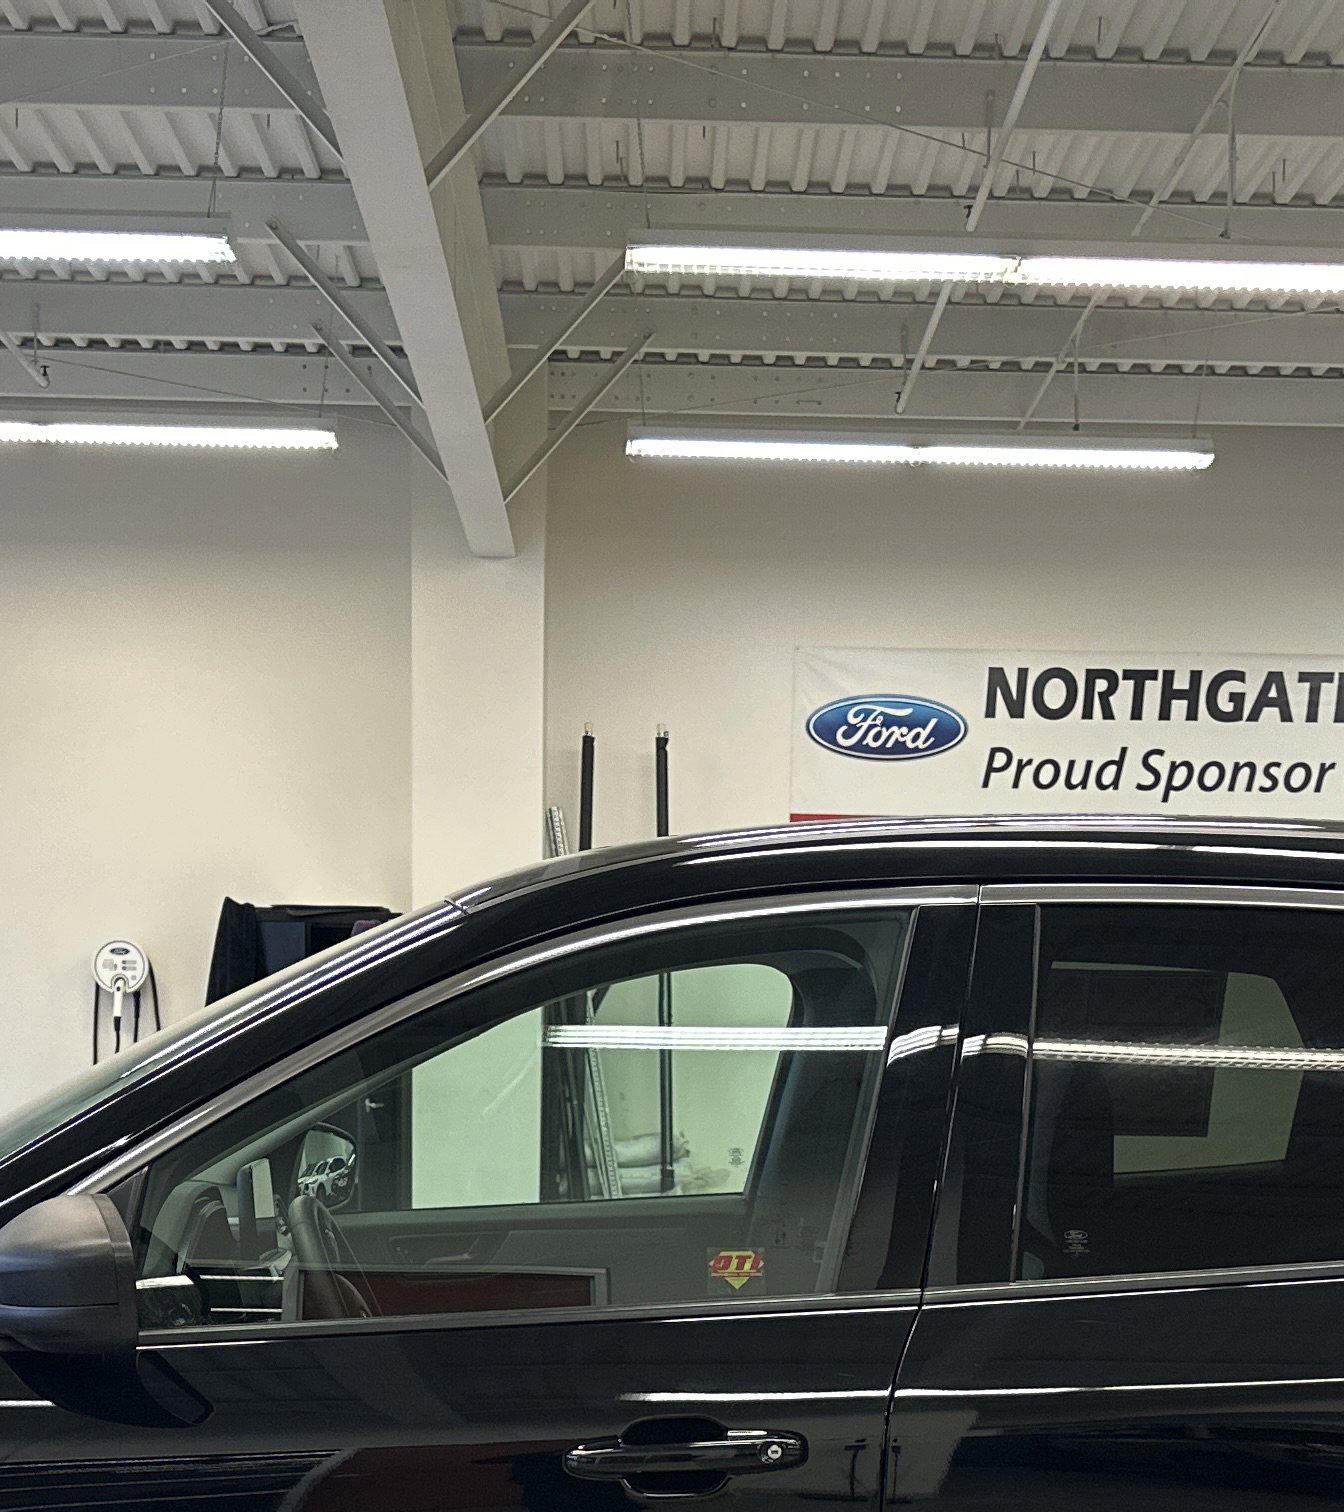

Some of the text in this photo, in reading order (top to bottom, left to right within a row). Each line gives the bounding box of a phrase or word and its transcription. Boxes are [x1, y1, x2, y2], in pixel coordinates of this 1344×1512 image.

[835, 704, 939, 750] Ford
[981, 746, 1129, 791] Proud
[1135, 748, 1337, 804] Sponsor
